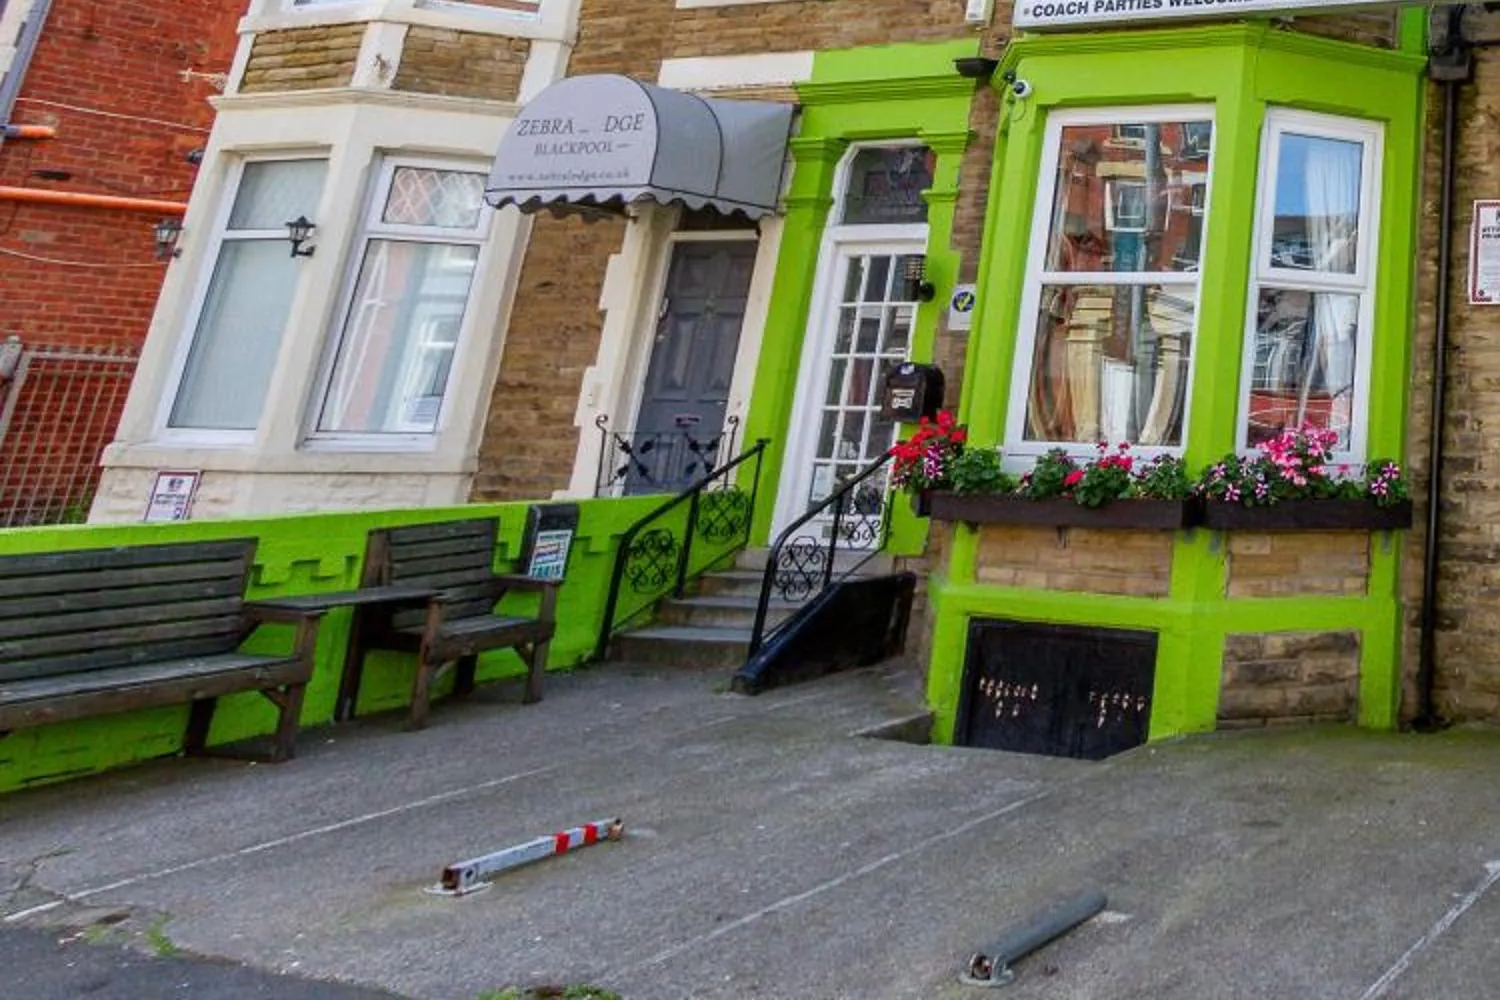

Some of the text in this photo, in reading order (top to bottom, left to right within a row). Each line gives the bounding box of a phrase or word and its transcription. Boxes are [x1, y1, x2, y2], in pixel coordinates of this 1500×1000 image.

[1032, 1, 1089, 17] COACH
[517, 118, 574, 137] ZEBRA
[534, 140, 613, 155] BLACKPOOL
